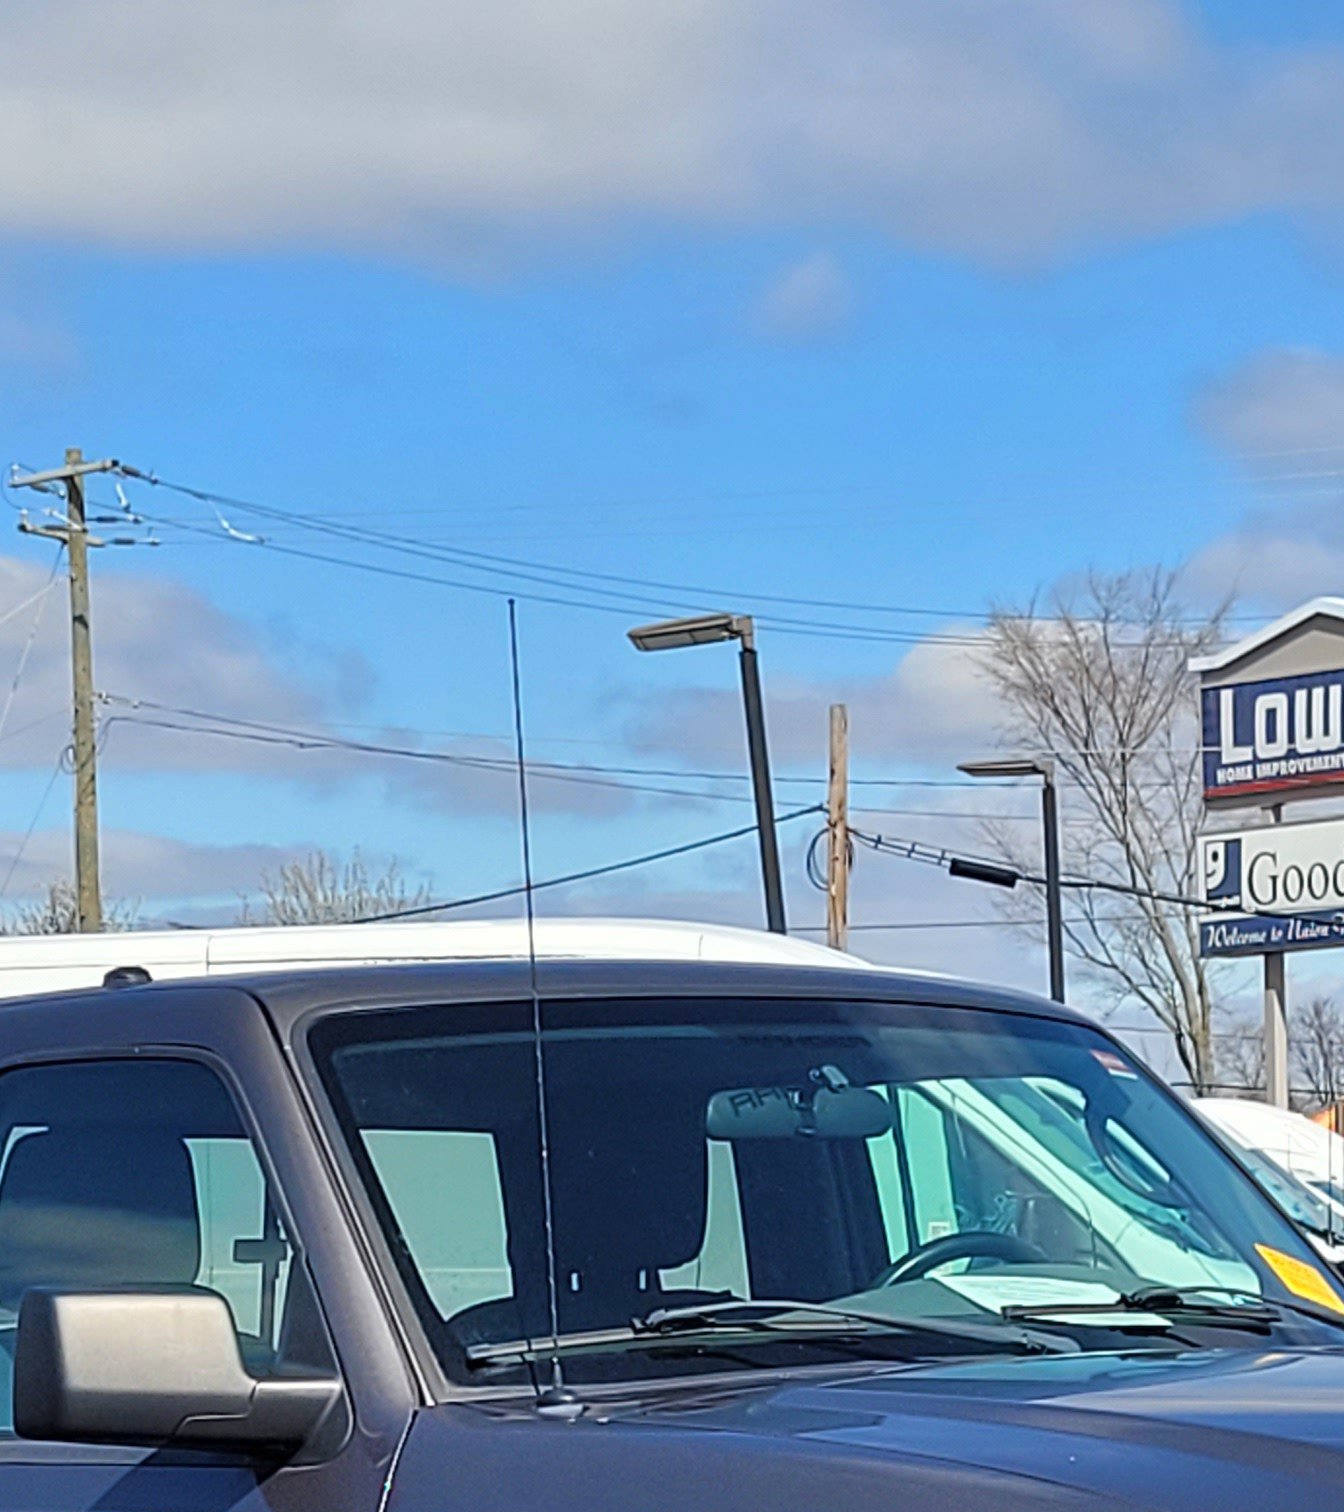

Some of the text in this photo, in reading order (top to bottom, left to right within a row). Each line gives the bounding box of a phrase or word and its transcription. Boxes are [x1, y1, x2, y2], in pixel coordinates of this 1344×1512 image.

[1216, 763, 1254, 785] HOME
[1207, 923, 1268, 948] Welcome
[1271, 925, 1284, 942] to
